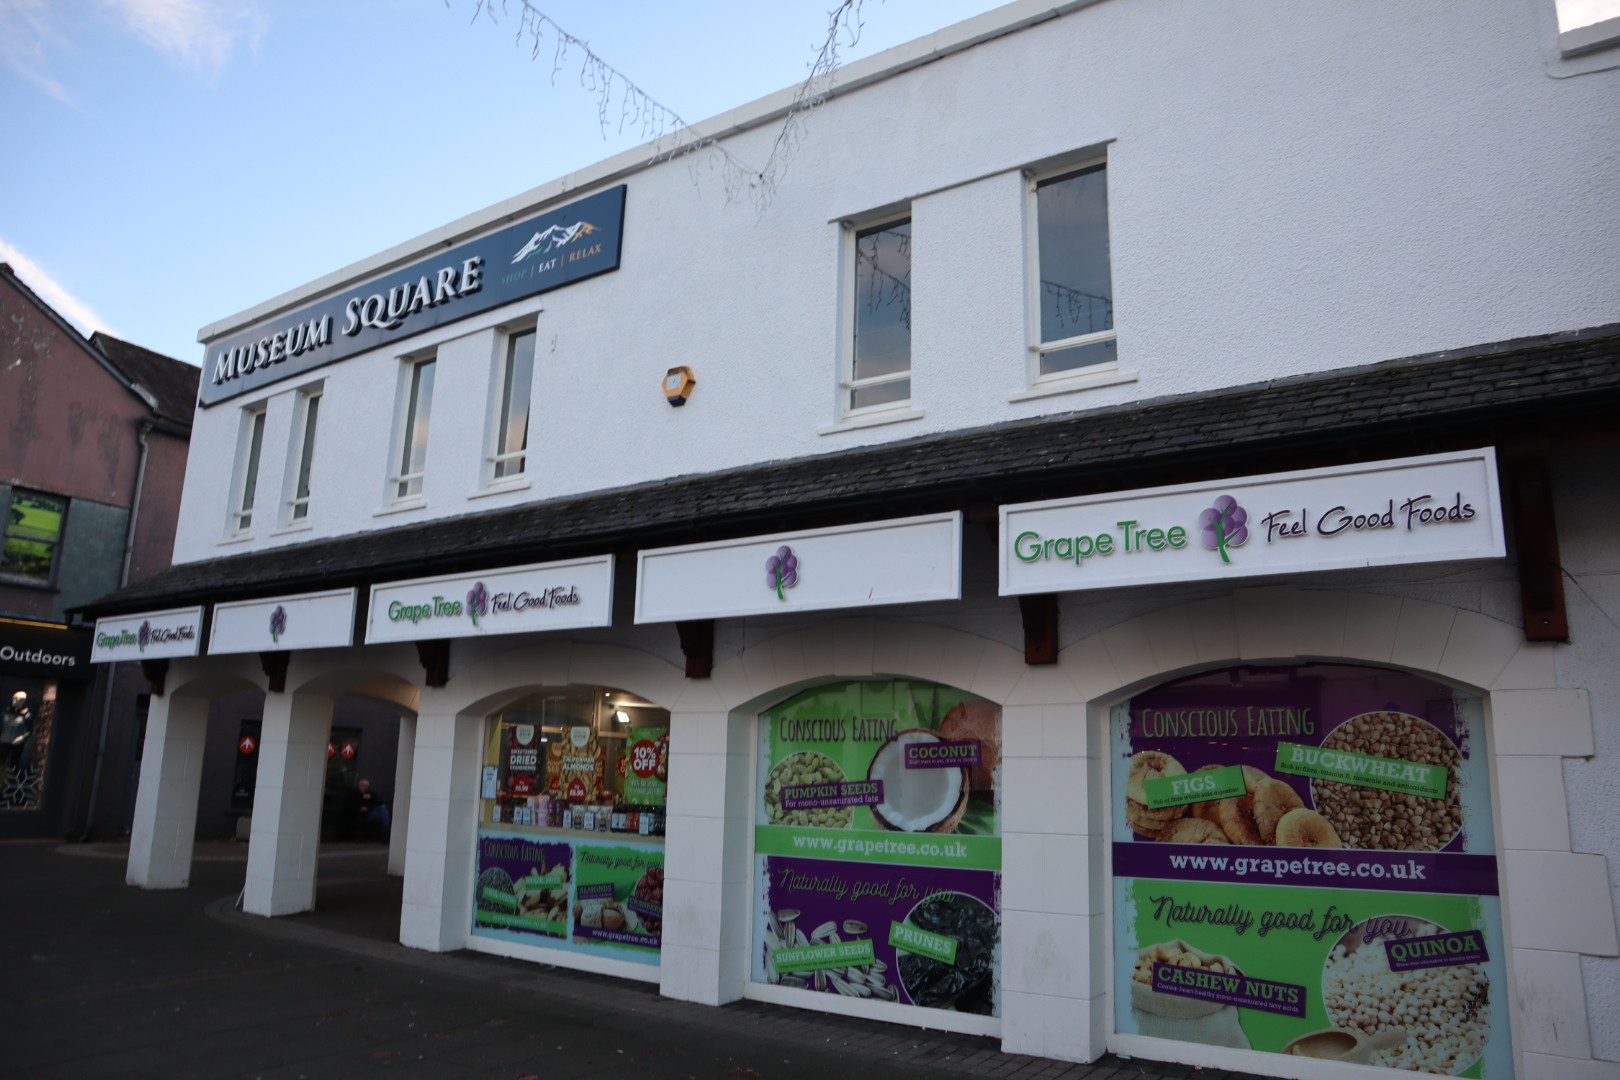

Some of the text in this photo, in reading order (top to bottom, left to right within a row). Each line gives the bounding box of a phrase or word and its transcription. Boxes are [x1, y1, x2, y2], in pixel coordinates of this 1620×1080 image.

[538, 258, 557, 273] EAT
[569, 243, 602, 263] RELAX
[211, 255, 485, 384] MUSEUM SQUARE
[1013, 492, 1477, 566] Grape Tree Feel Good Foods
[388, 585, 580, 624] Grape Tree Feel Good Foods
[0, 645, 76, 667] Outdoors
[510, 755, 537, 765] DRIED
[633, 746, 656, 760] 10%
[909, 744, 977, 760] COCONUT
[562, 763, 595, 771] ALMONDS
[633, 759, 656, 771] OFF
[1290, 746, 1430, 783] BUCKWHEAT
[784, 782, 879, 800] PUMPKIN SEEDS
[1171, 775, 1217, 795] FIGS
[1383, 778, 1396, 787] and
[785, 800, 796, 808] For
[793, 835, 968, 858] www.grapetree.co.uk
[1169, 853, 1427, 881] www.grapetree.co.uk
[777, 868, 957, 908] Naturally good for you
[1149, 896, 1413, 943] Naturally good for you
[894, 925, 952, 955] PRUNES
[1391, 935, 1480, 961] QUINOA
[776, 947, 836, 963] SUNFLOWER
[839, 943, 871, 957] SEEDS
[1158, 966, 1300, 1004] CASHEW NUTS
